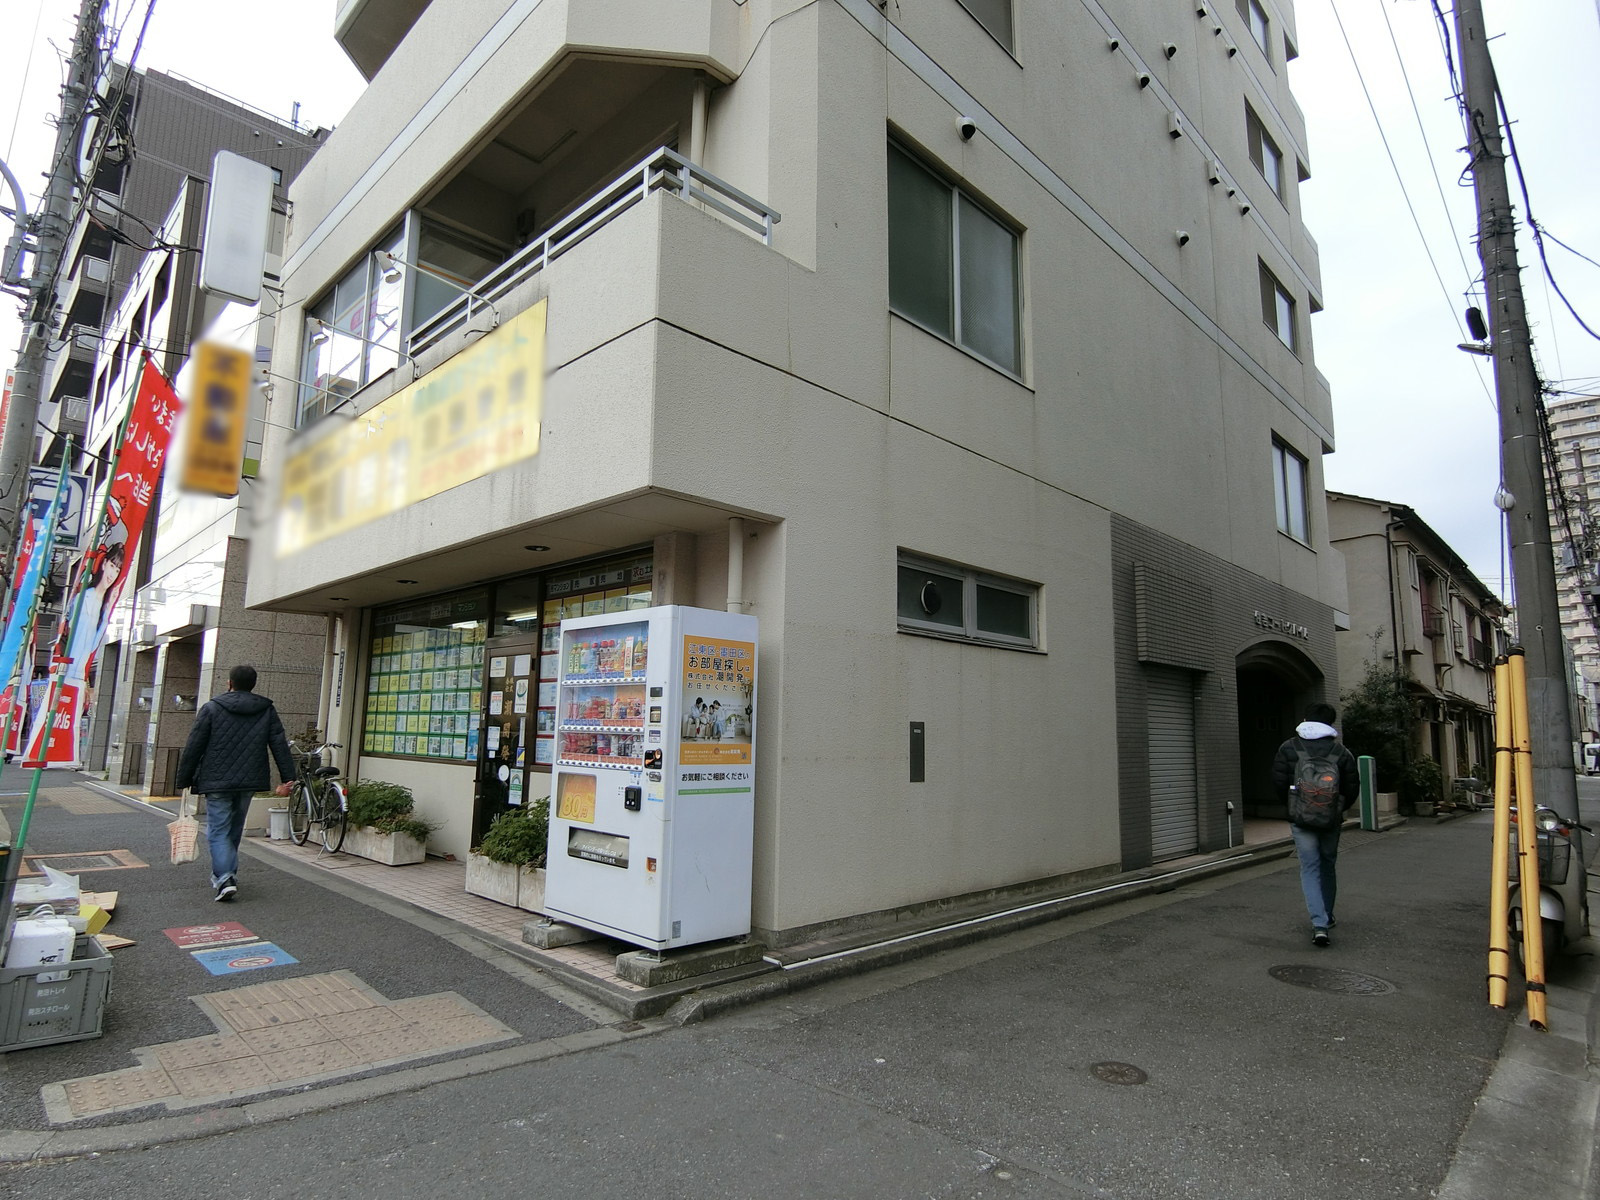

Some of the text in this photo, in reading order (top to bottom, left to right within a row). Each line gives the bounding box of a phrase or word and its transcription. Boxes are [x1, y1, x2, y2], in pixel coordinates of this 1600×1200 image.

[688, 656, 750, 672] お部屋探しは
[681, 772, 749, 782] お気軽にご相談ください
[28, 1004, 70, 1016] 発泡スチロール
